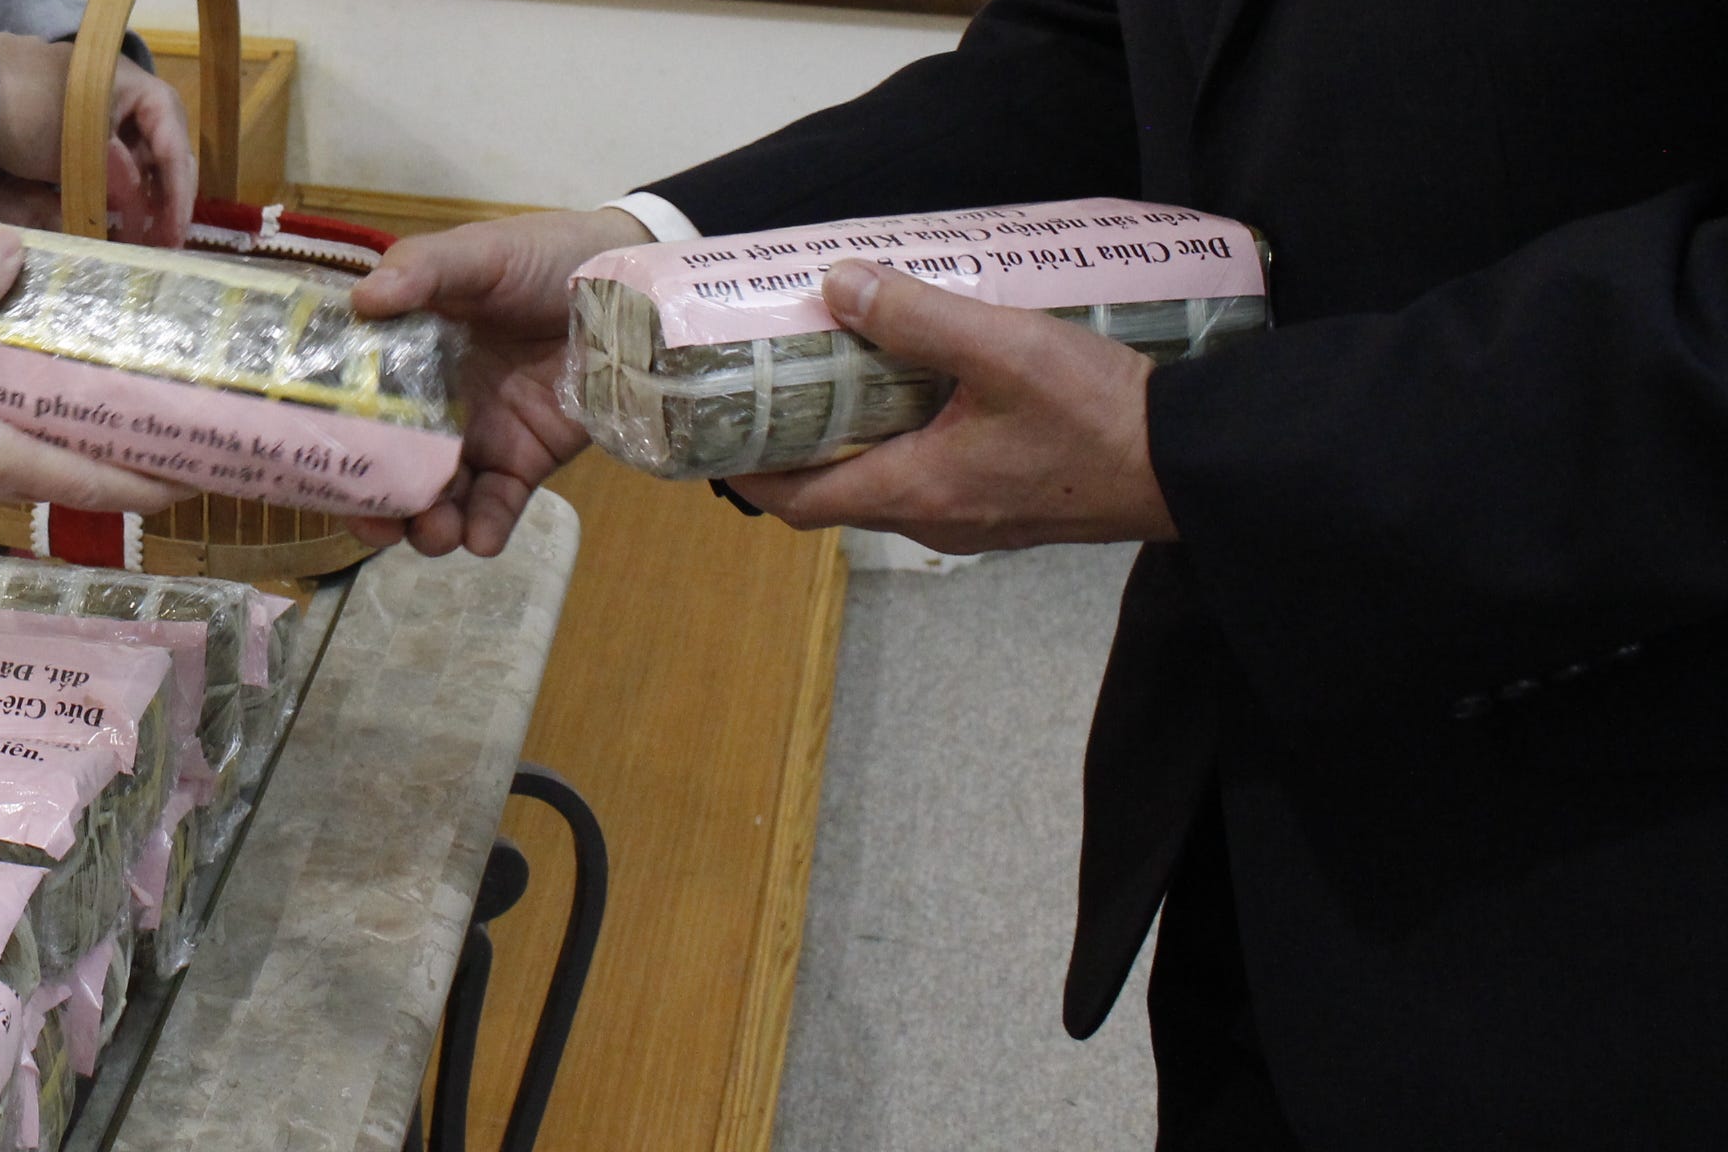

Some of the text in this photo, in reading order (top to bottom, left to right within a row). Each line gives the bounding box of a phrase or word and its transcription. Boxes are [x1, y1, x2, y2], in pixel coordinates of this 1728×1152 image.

[997, 217, 1089, 237] nghiệp
[1145, 212, 1201, 226] trên
[806, 238, 840, 250] nó
[847, 233, 904, 250] Khi
[904, 228, 992, 244] Chúa,
[1178, 236, 1233, 260] Đức
[746, 243, 799, 262] mệt
[986, 249, 1024, 273] ơi,
[1029, 247, 1095, 271] Trời
[1097, 240, 1170, 266] Chúa
[694, 271, 813, 301] mưa lớn
[34, 395, 124, 428] phước
[131, 414, 181, 439] cho
[0, 661, 34, 681] Đã
[44, 664, 90, 691] đất,
[54, 701, 105, 728] Đức
